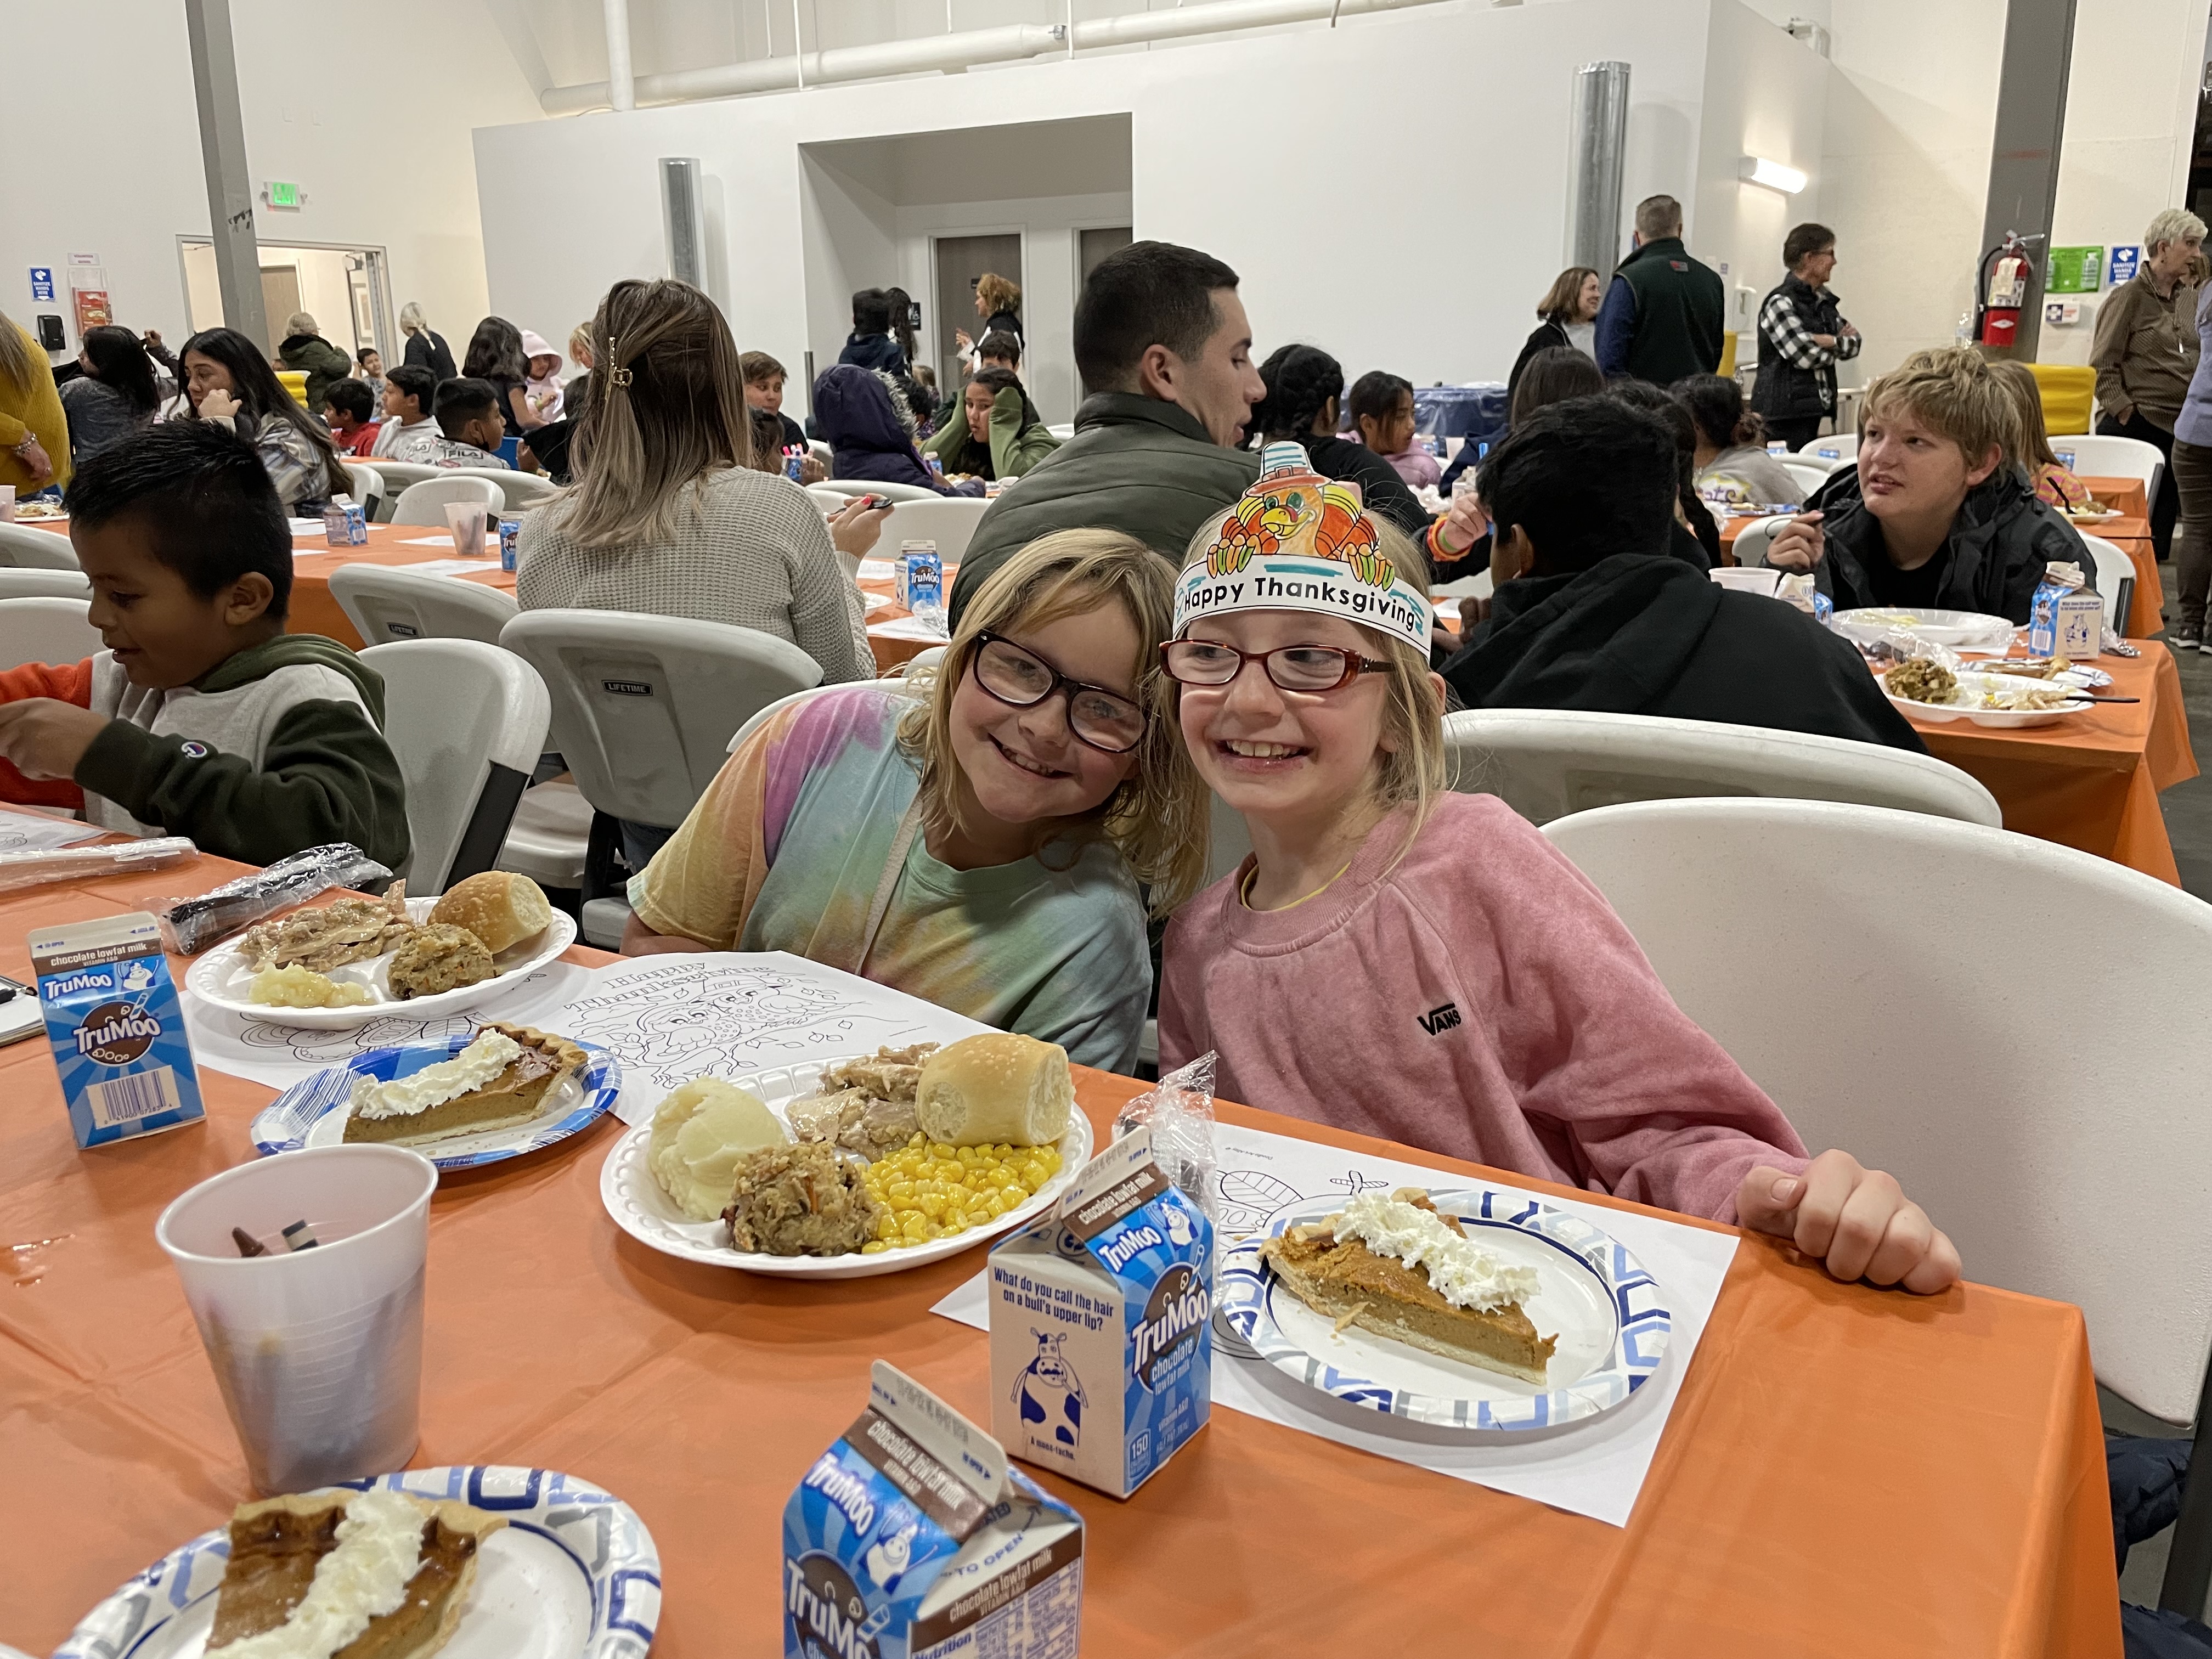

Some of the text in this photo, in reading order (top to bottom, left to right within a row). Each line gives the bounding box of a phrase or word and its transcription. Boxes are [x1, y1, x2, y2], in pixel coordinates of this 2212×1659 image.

[503, 538, 516, 548] Tru
[911, 572, 940, 584] TruMoo
[1185, 577, 1415, 632] Happy Thanksgiving
[608, 683, 646, 693] LIFETIME
[50, 943, 148, 967] chocolate lowfat milk
[602, 962, 706, 989] Happy
[44, 974, 112, 1000] TruMoo
[74, 1018, 161, 1054] TruMoo
[1417, 1002, 1462, 1036] VANS
[1079, 1195, 1118, 1225] chocolate
[1110, 1181, 1140, 1204] lowfat
[1134, 1171, 1155, 1189] milk
[1098, 1226, 1163, 1273] TruMoo
[994, 1266, 1114, 1317] What do you call the hair
[1003, 1289, 1103, 1331] on a bull's upper lip?
[1132, 1289, 1209, 1374] TruMoo
[1152, 1338, 1193, 1383] chocolate
[1155, 1358, 1190, 1396] lowfat milk
[867, 1420, 916, 1466] chocolate
[1132, 1434, 1148, 1459] 150
[806, 1452, 874, 1537] TruMoo
[955, 1532, 1024, 1579] TO OPEN
[950, 1548, 1053, 1623] chocolate lowfat milk
